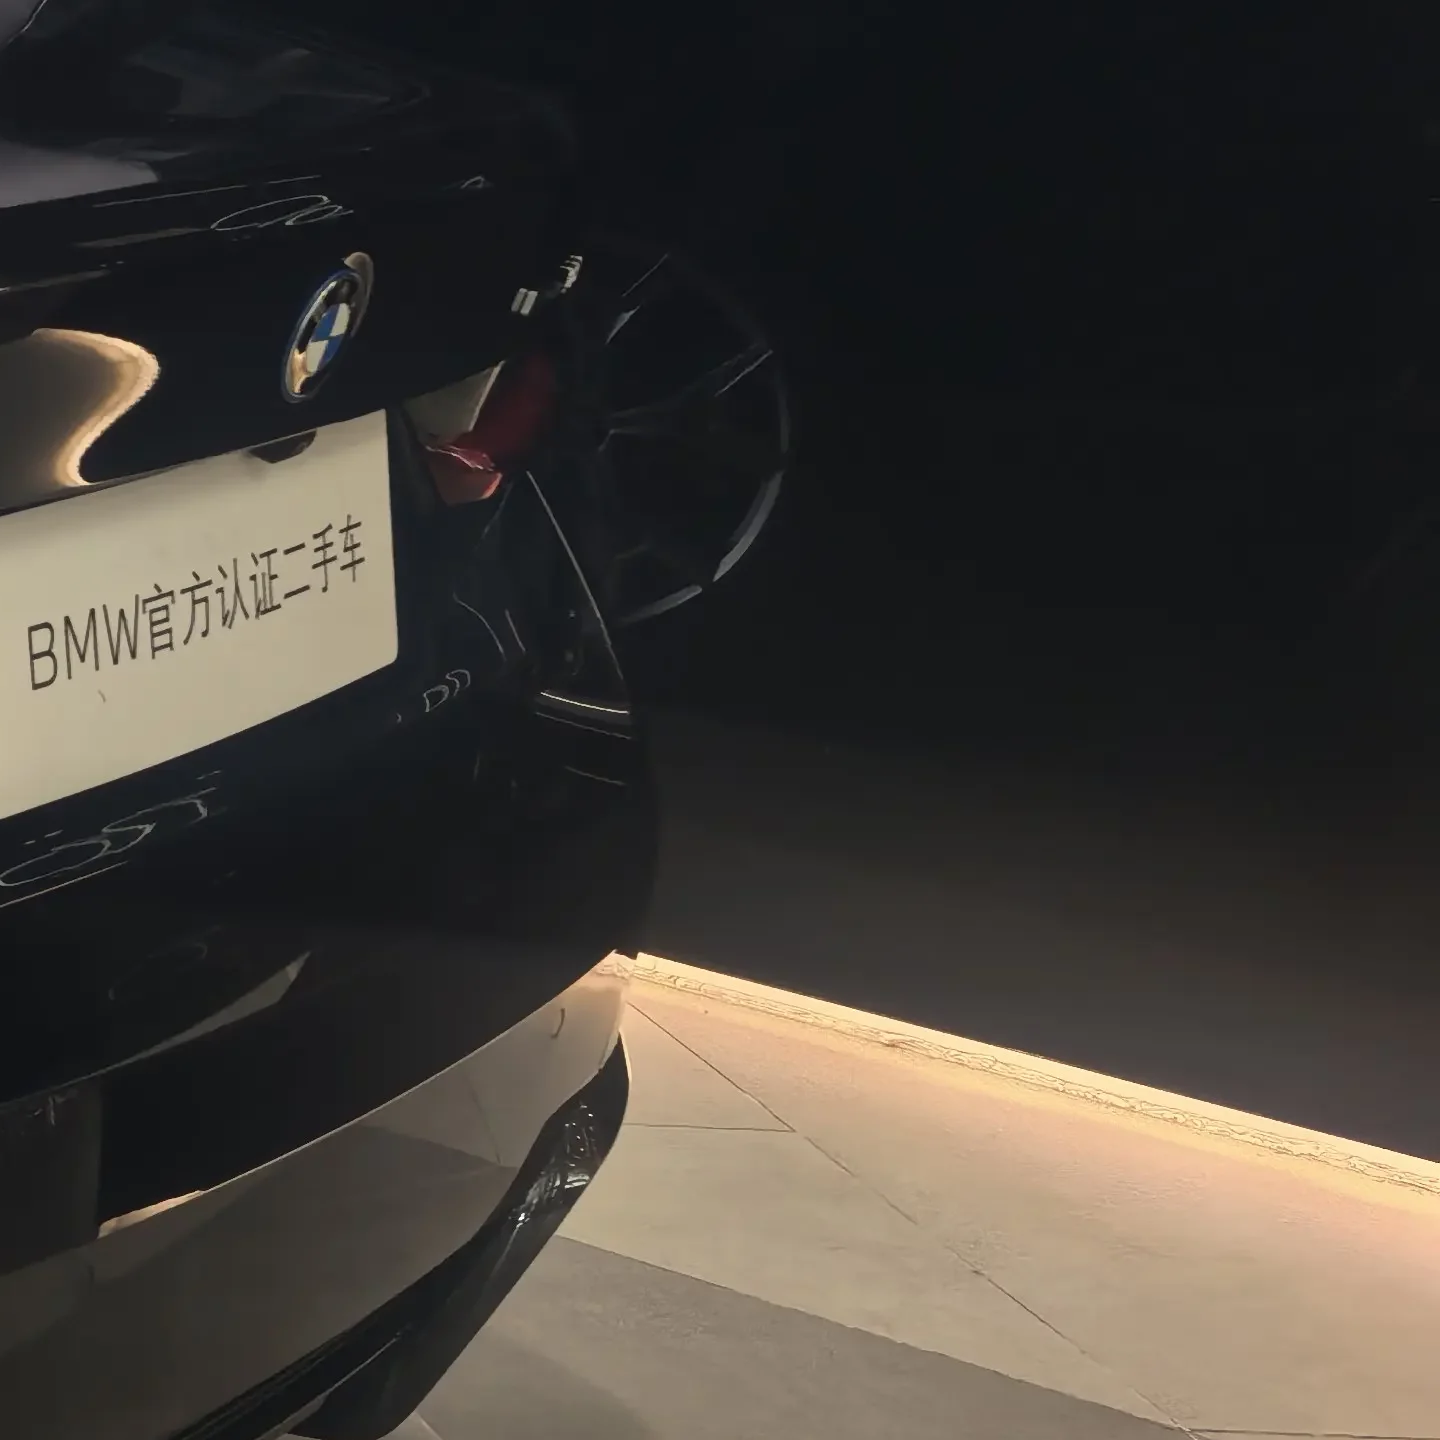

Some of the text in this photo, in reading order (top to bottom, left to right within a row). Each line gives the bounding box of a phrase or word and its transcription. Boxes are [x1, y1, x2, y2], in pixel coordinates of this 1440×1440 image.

[26, 513, 367, 691] BMW官方认证二手车
